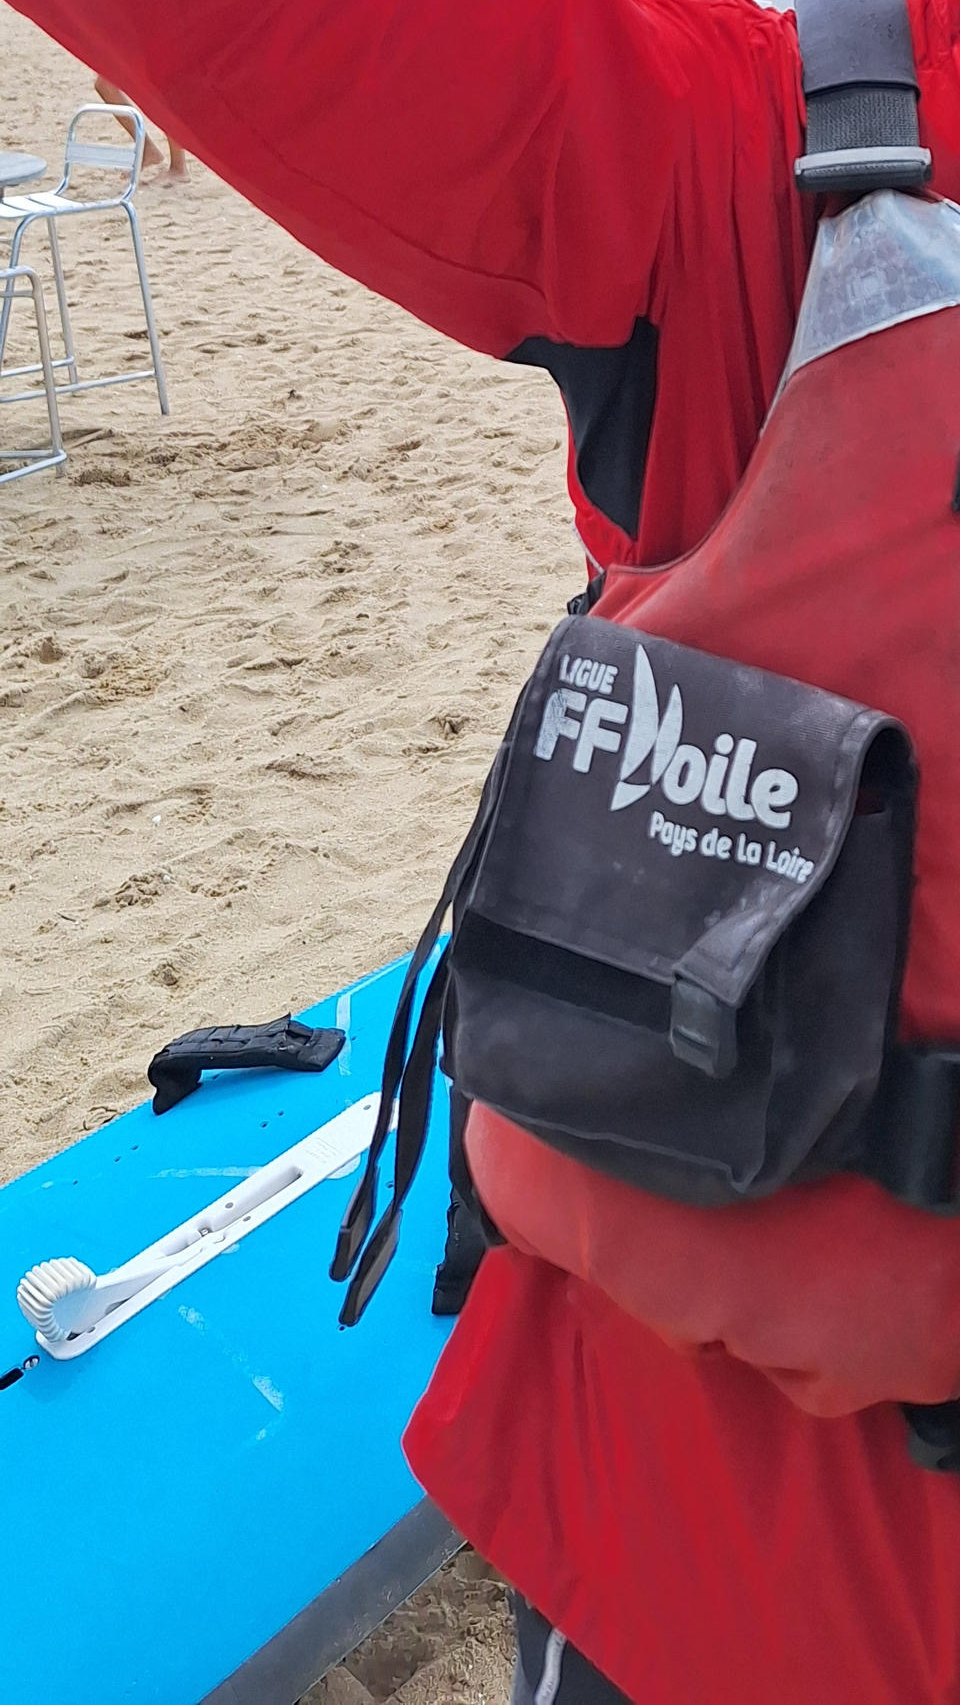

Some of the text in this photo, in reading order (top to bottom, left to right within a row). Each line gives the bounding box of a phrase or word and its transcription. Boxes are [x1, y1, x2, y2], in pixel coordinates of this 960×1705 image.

[558, 653, 619, 695] LIGUE
[649, 810, 815, 884] Pays de la Loire
